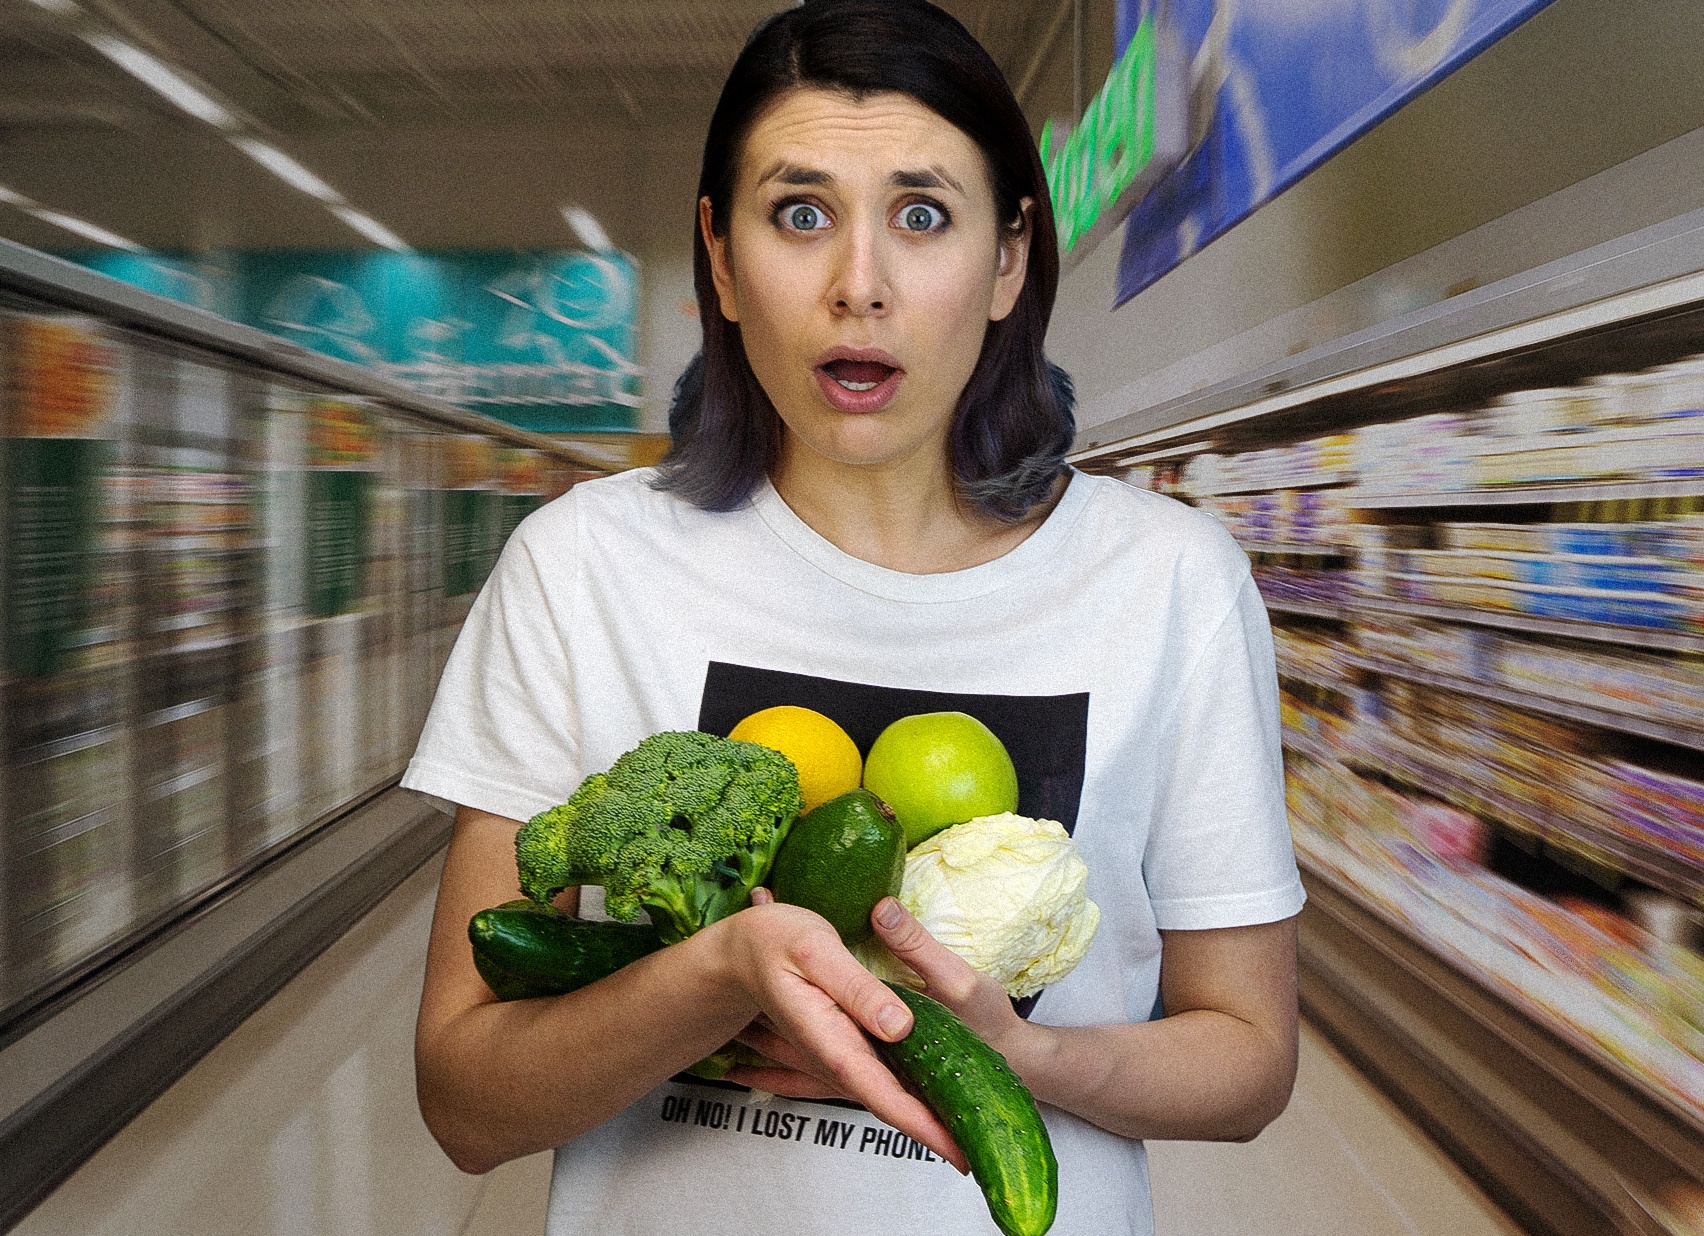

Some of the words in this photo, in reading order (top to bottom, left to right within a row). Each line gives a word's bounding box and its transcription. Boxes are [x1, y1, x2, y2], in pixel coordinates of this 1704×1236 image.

[661, 1096, 691, 1123] OH
[694, 1100, 732, 1130] NO!
[736, 1106, 746, 1132] I
[751, 1108, 811, 1142] LOST
[814, 1118, 855, 1149] MY
[859, 1126, 947, 1164] PHON
